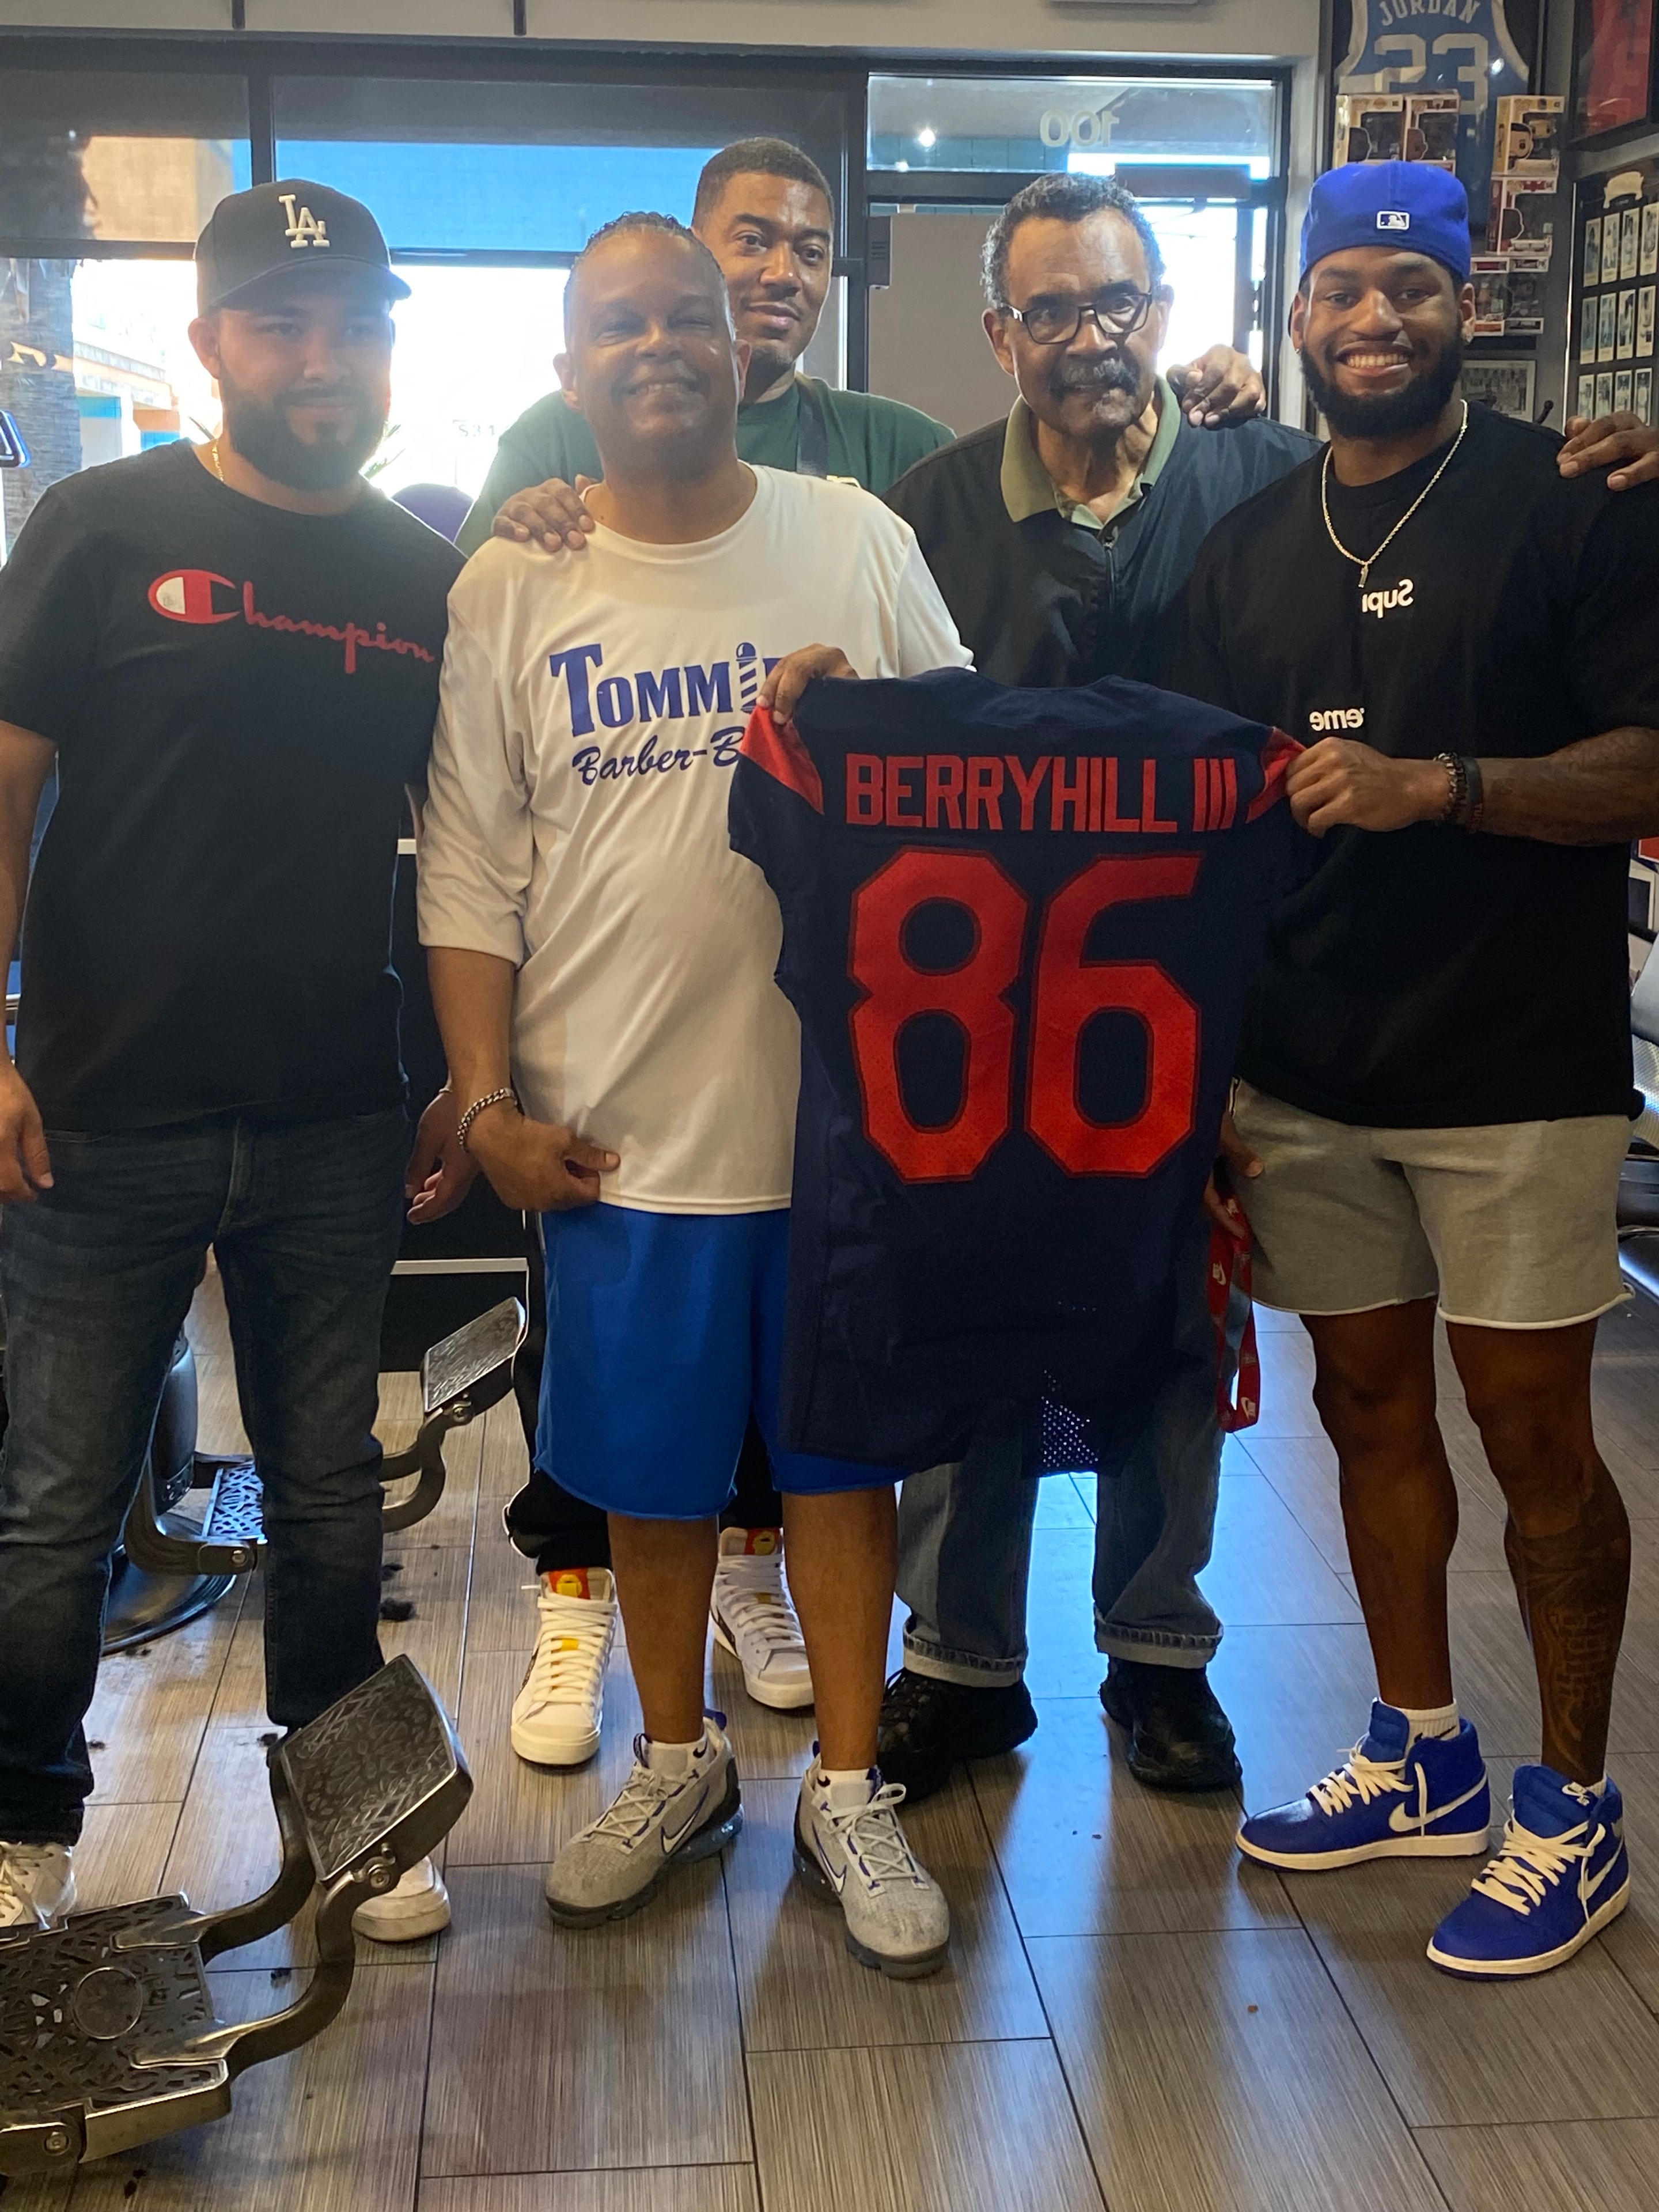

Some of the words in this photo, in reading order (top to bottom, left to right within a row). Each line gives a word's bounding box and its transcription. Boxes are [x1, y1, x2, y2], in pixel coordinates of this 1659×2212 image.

[1379, 0, 1480, 26] JORDAN
[1374, 33, 1488, 115] 23
[278, 194, 331, 248] LA
[147, 569, 435, 675] Champion
[550, 642, 787, 737] TOMMI
[846, 753, 1177, 832] BERRYHILL
[1192, 757, 1238, 831] III
[848, 847, 1205, 1184] 86
